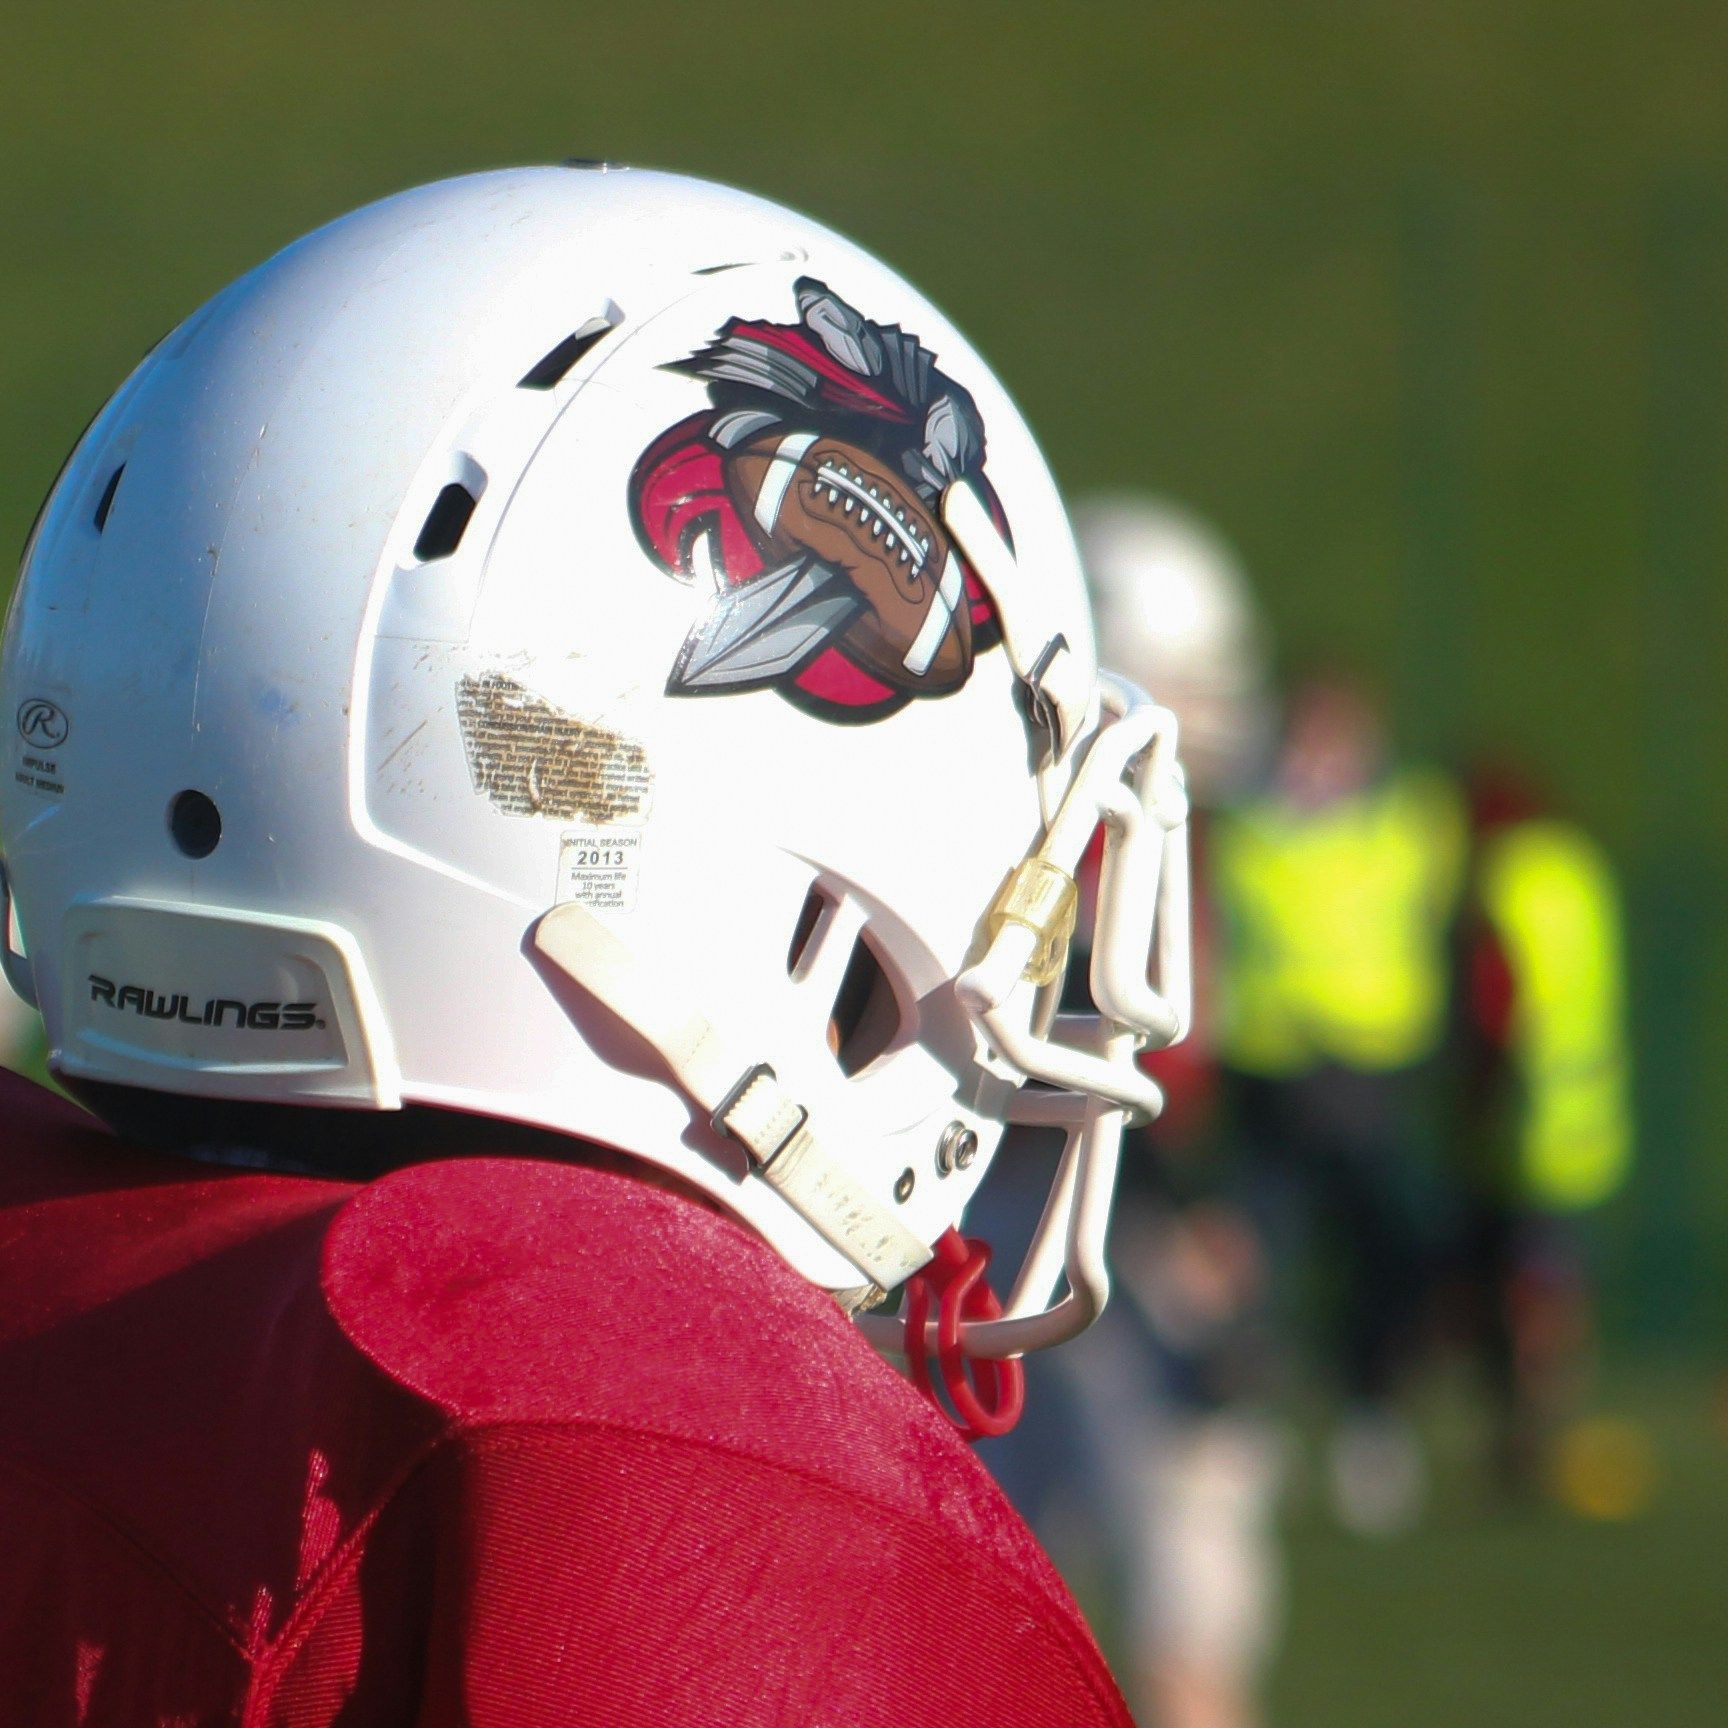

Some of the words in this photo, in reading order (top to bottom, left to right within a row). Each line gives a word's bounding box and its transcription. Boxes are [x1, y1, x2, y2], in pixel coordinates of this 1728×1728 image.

[600, 838, 637, 847] SEASON
[577, 850, 624, 865] 2013
[571, 872, 612, 881] Maximum
[582, 882, 593, 890] 10
[594, 883, 615, 891] years
[88, 974, 317, 1030] RAWLINGS
